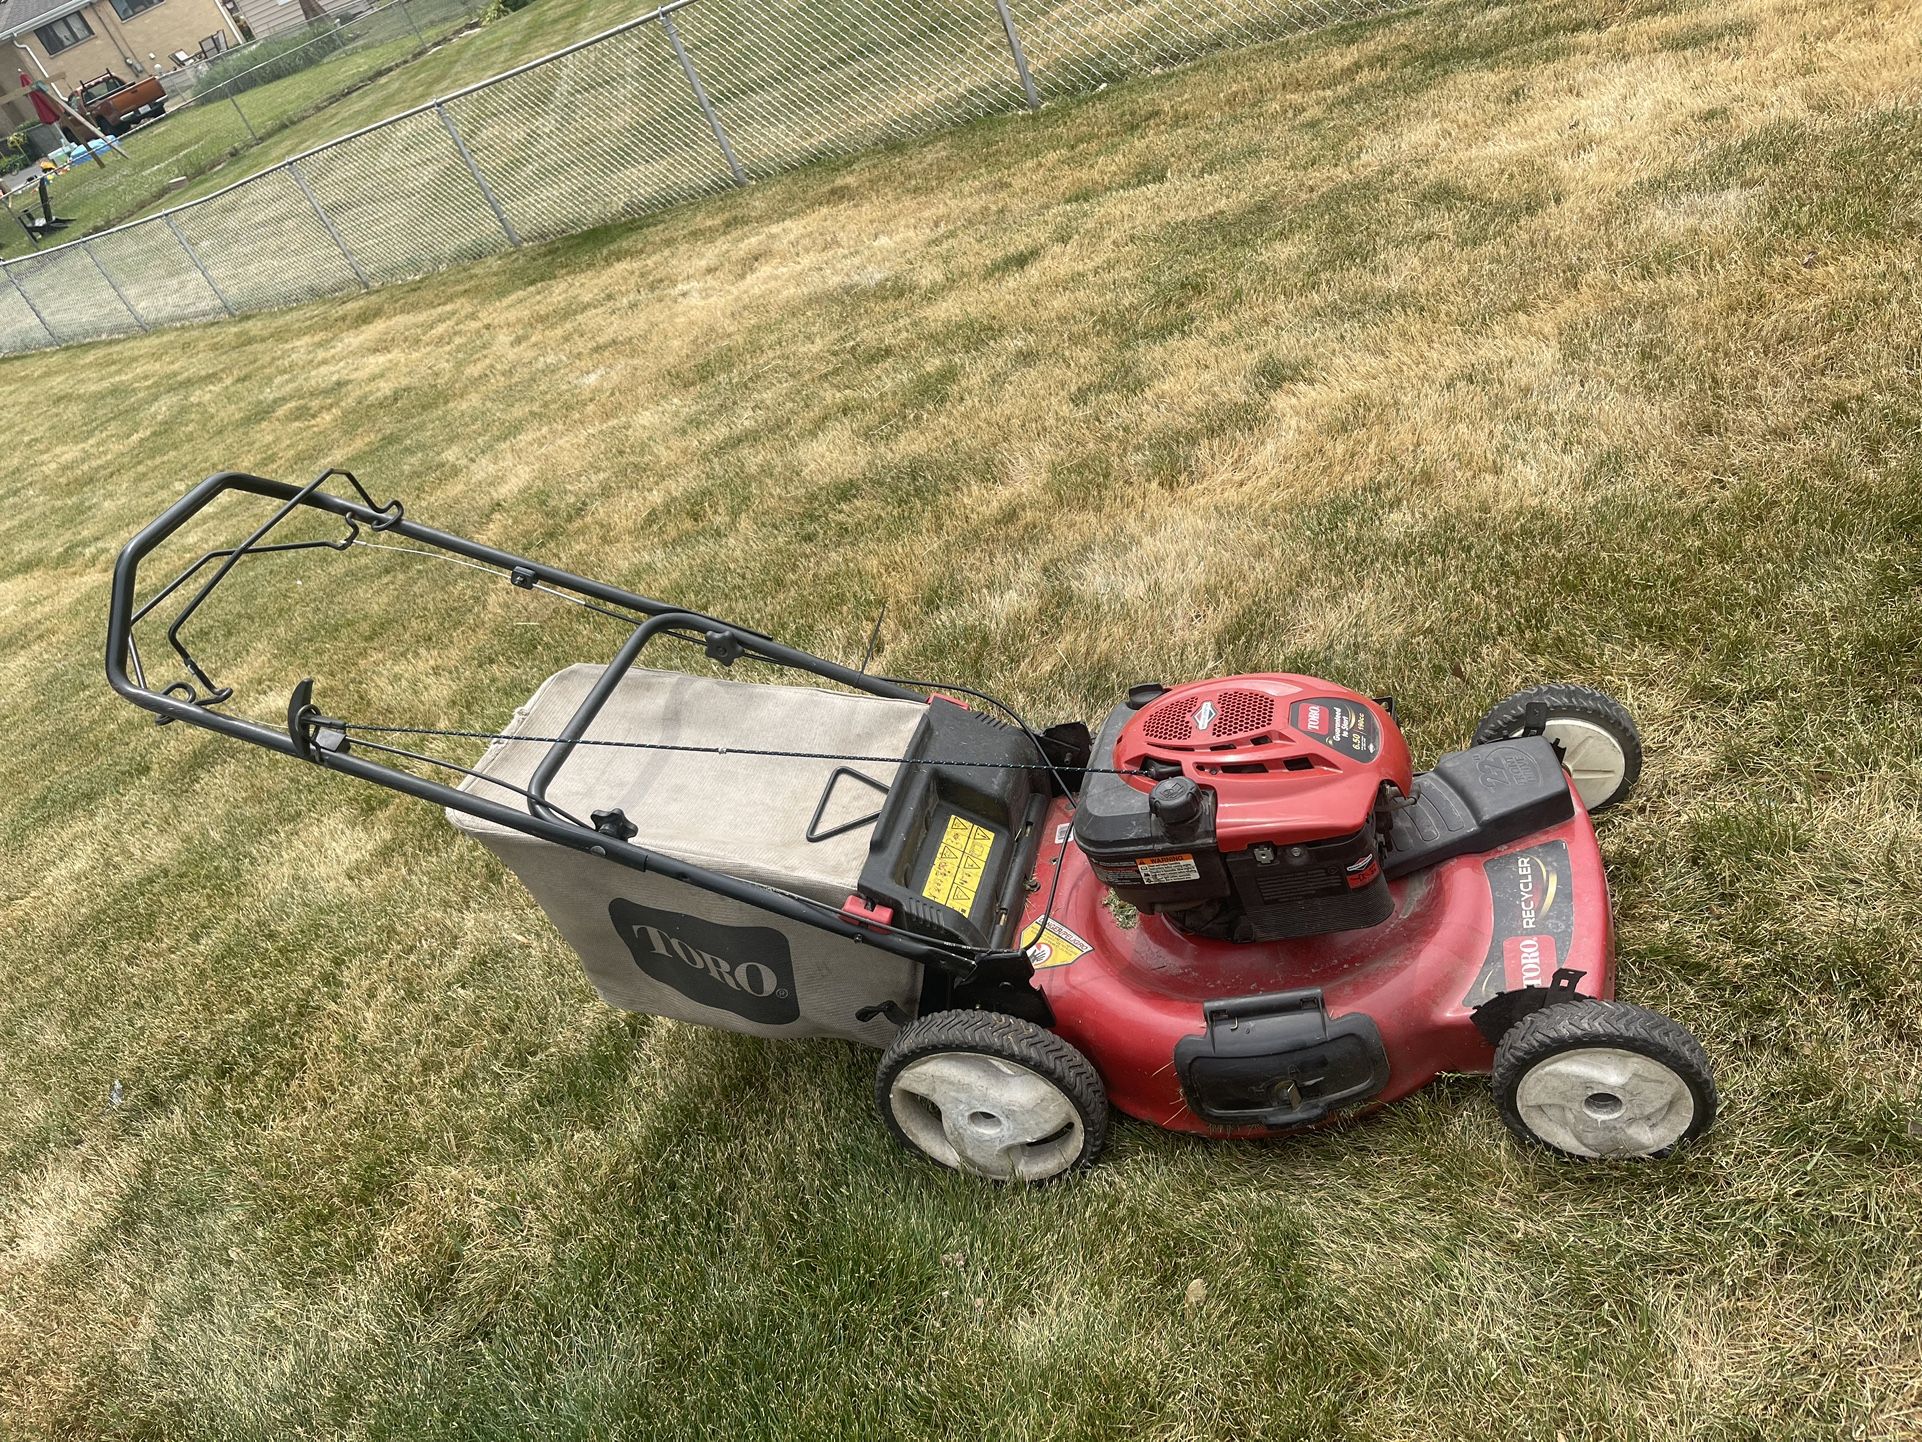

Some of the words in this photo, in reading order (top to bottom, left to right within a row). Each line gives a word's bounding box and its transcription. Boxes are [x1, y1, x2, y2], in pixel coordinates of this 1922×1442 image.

[1308, 706, 1320, 730] TORO
[1333, 706, 1342, 742] Guaranteed
[1341, 716, 1349, 731] Start
[1341, 730, 1349, 738] to
[1352, 733, 1361, 750] 6.50
[1357, 712, 1365, 730] 190cc
[1151, 855, 1184, 865] WARNING
[1517, 856, 1536, 929] RECYCLER
[632, 924, 778, 997] TORO
[1519, 939, 1542, 989] TORO
